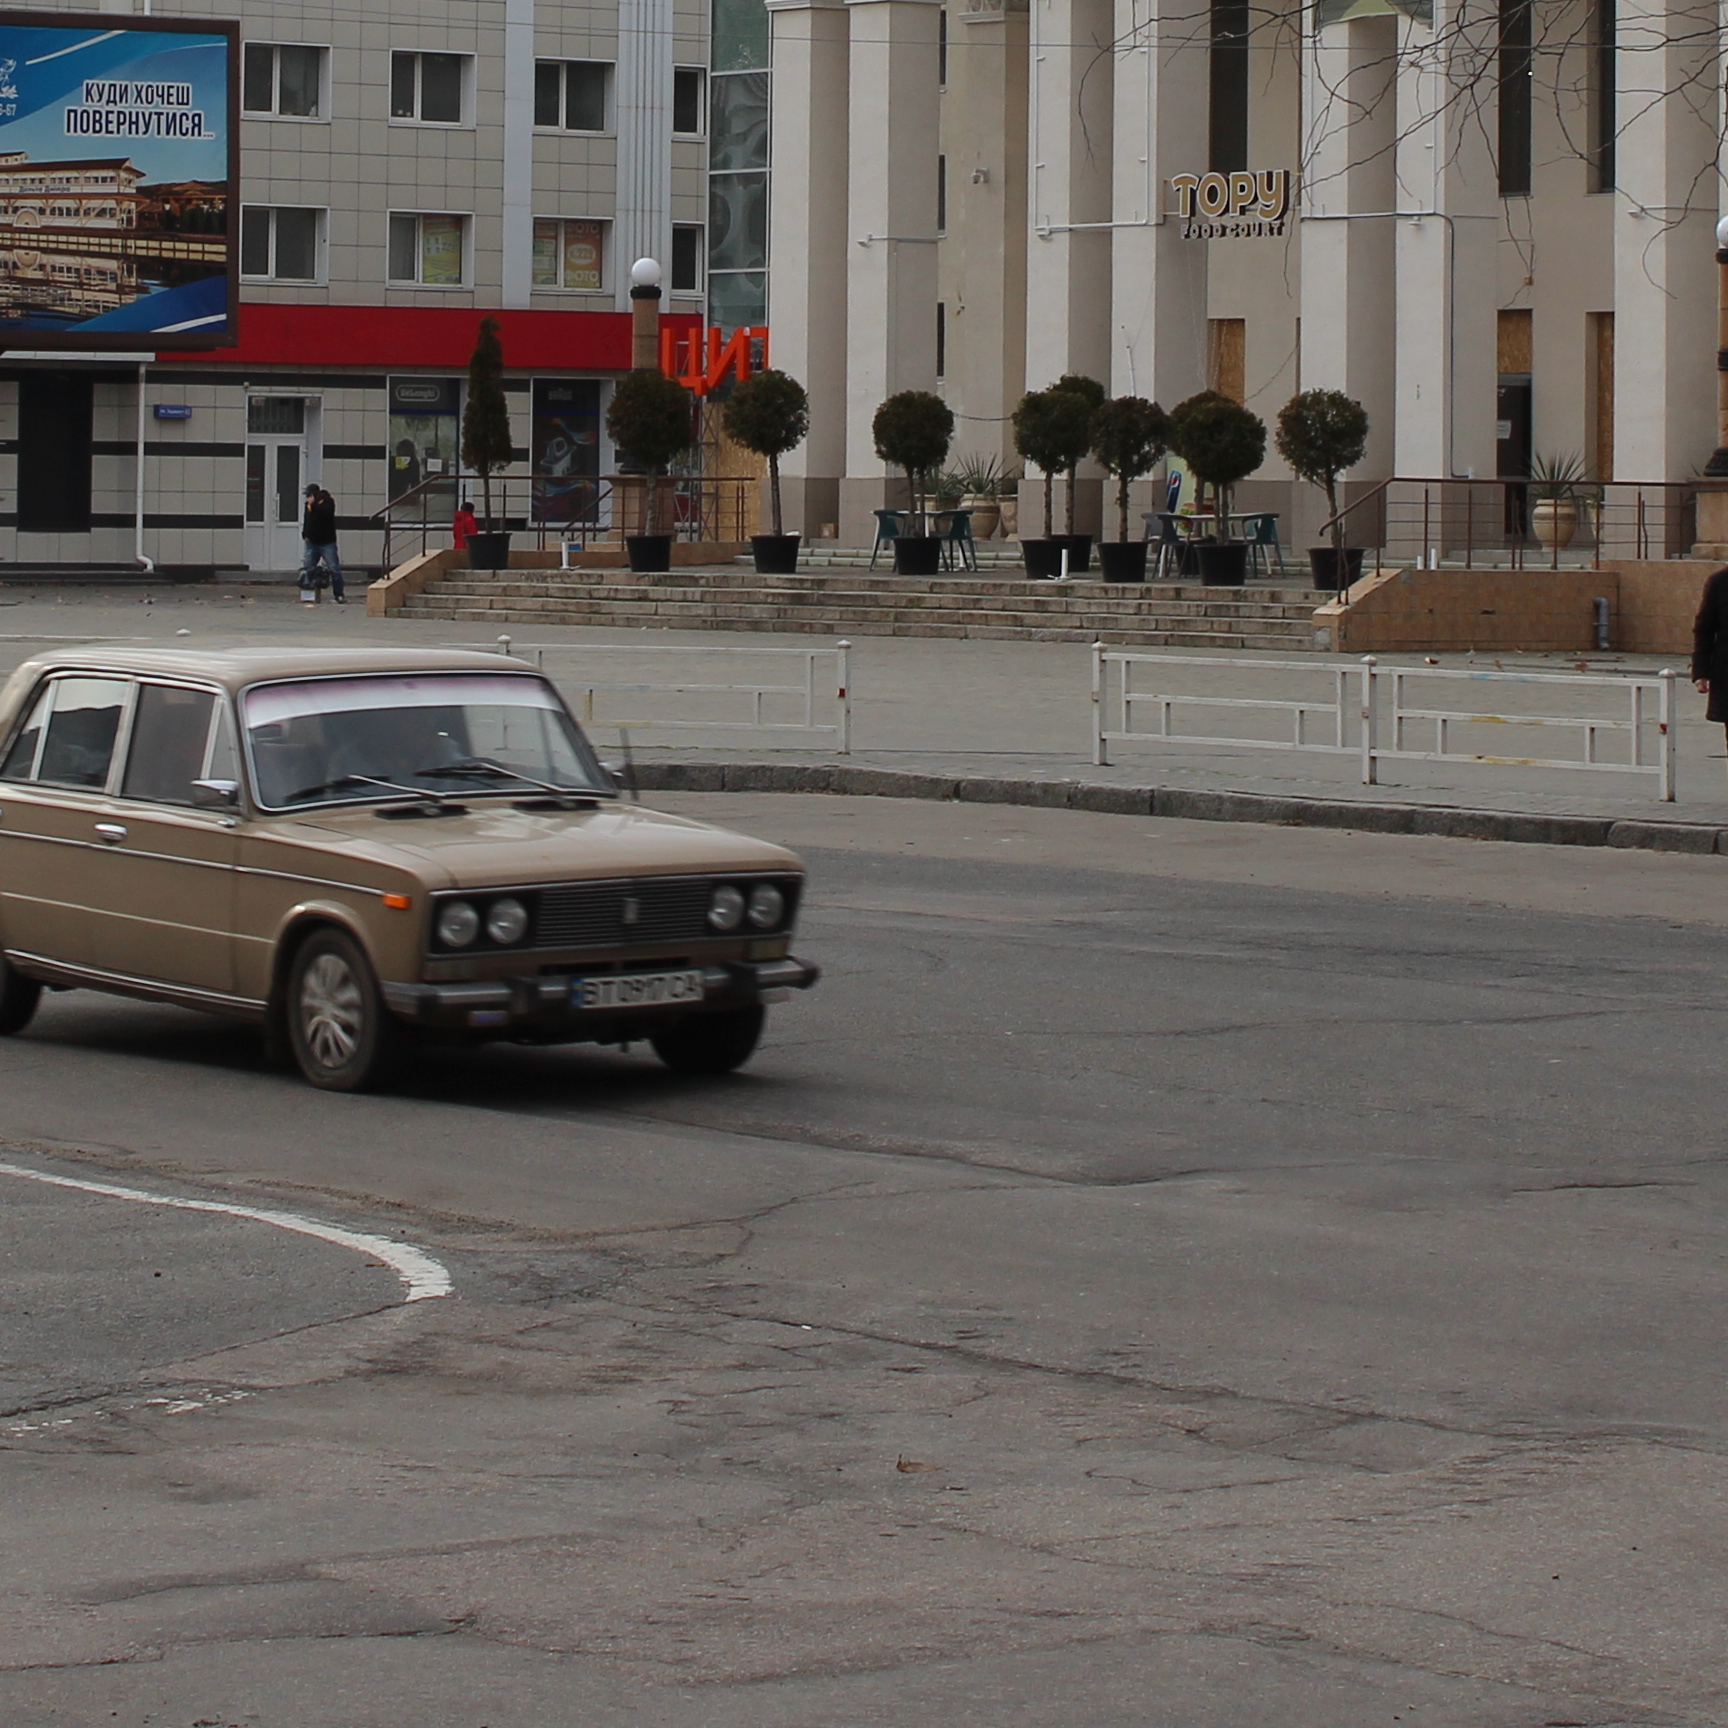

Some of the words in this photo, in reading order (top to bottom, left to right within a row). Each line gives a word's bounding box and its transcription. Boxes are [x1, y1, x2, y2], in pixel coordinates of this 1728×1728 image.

[84, 82, 129, 106] КУДИ
[134, 84, 191, 106] ХОЧЕШ
[1180, 223, 1226, 239] FOOD
[1227, 221, 1285, 237] COURT
